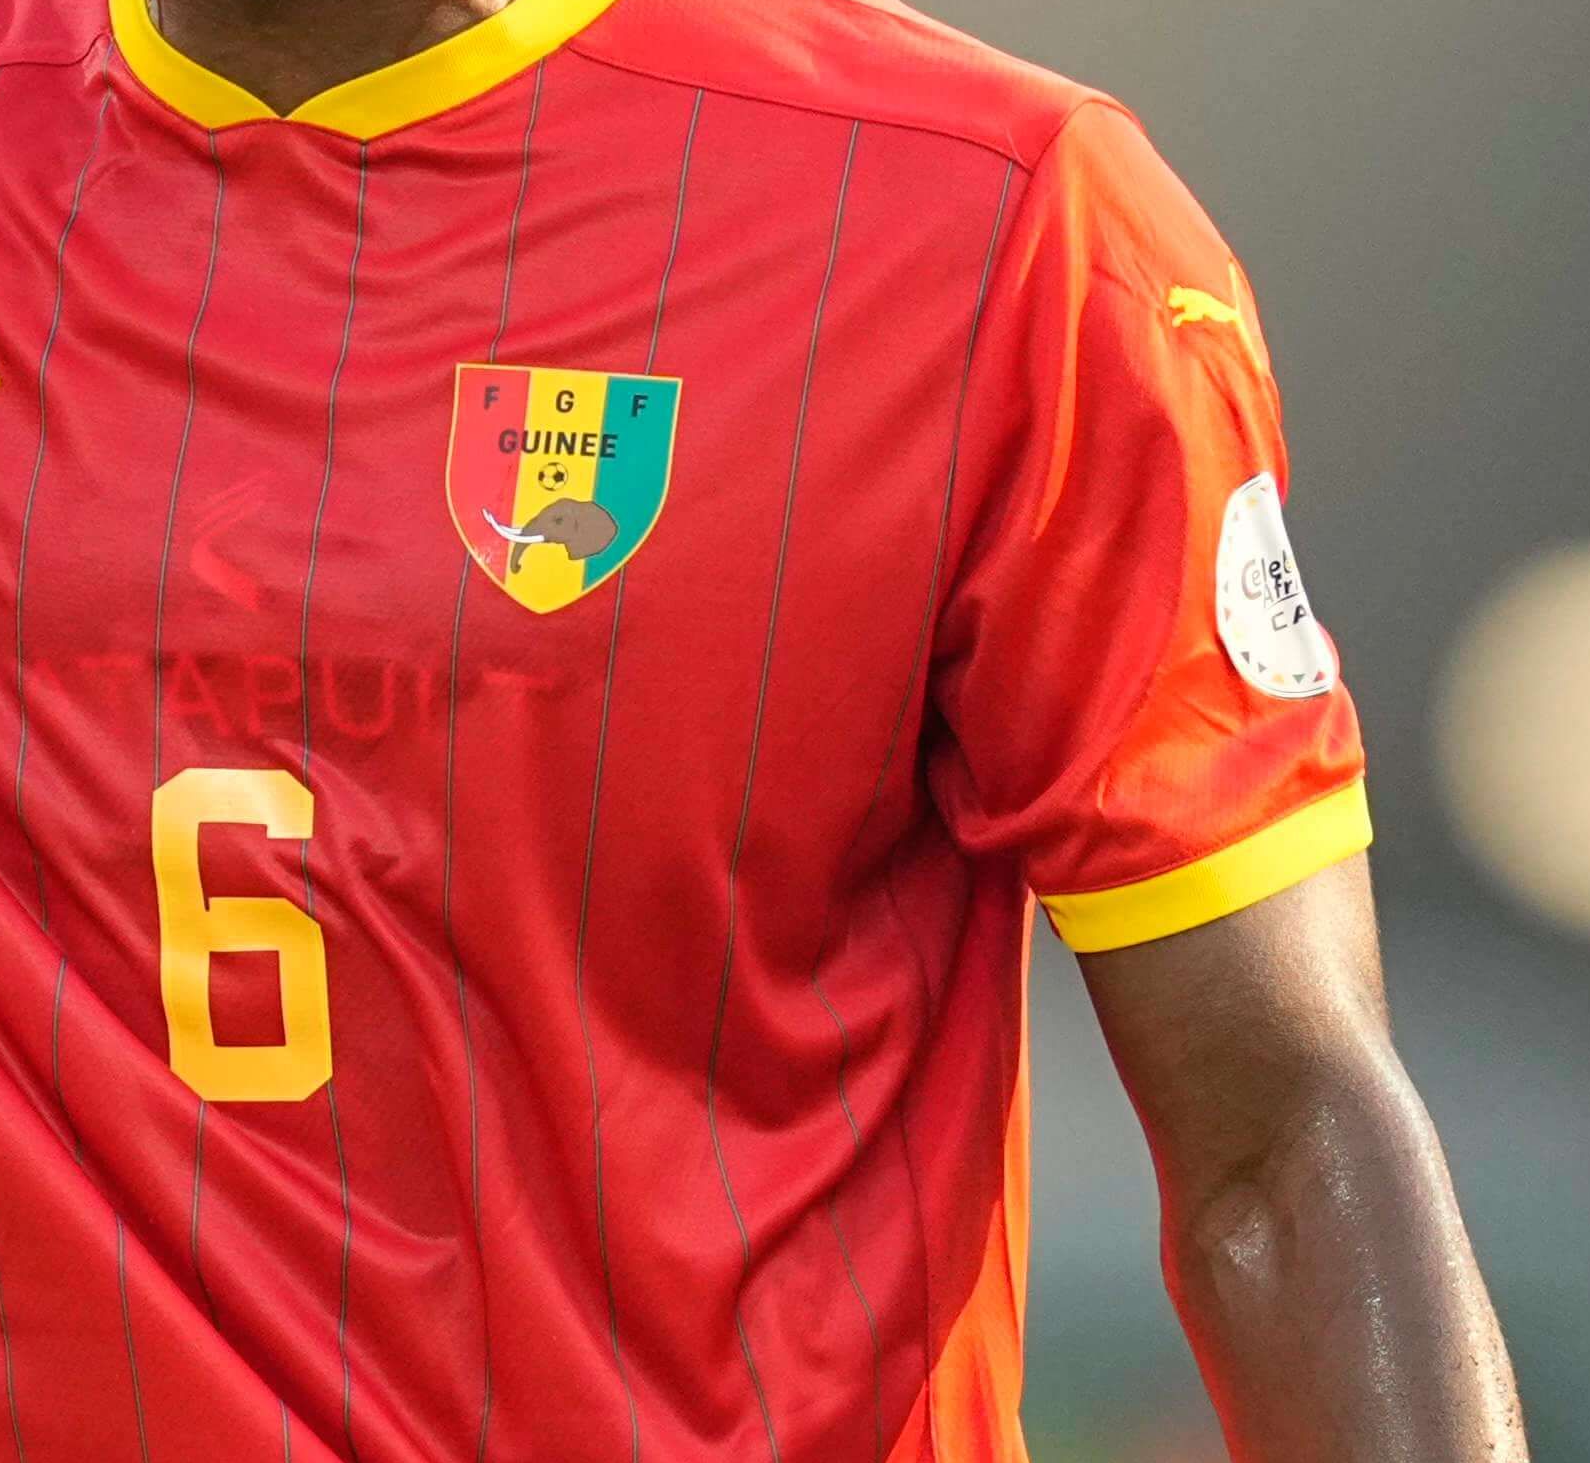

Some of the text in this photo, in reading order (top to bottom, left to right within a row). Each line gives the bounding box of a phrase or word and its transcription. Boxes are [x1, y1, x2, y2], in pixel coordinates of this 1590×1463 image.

[483, 386, 649, 418] F G F
[498, 429, 619, 459] GUINEE
[151, 767, 333, 1102] 6
